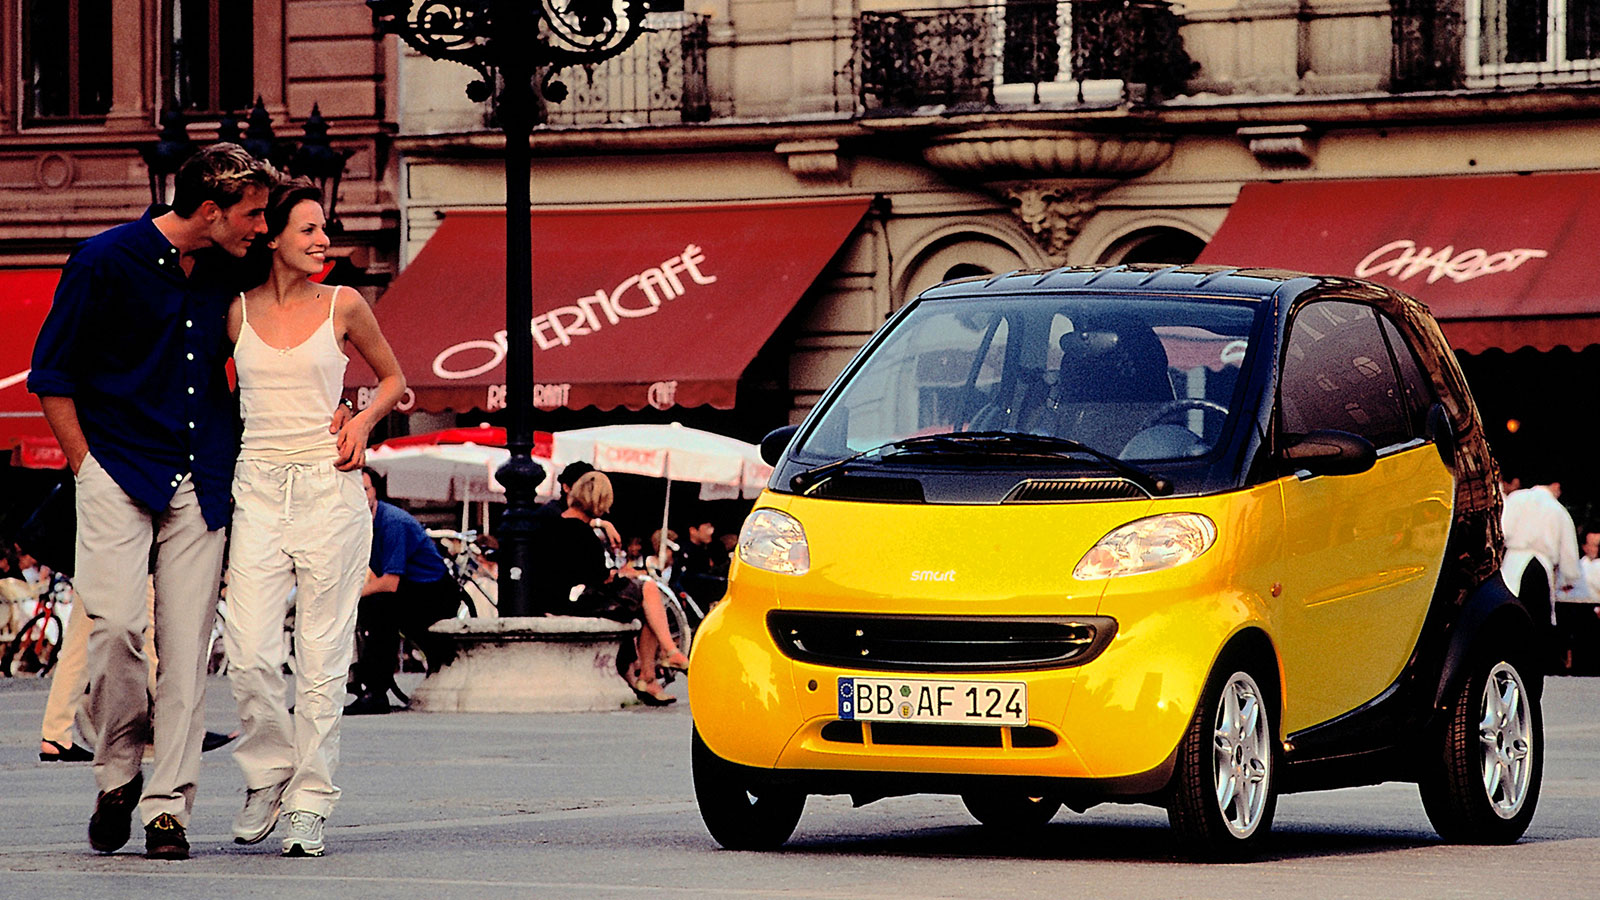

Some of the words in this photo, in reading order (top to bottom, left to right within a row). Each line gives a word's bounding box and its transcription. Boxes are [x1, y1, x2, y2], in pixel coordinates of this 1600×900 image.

[910, 569, 956, 582] smart
[857, 684, 894, 714] BB
[917, 686, 955, 716] AF
[965, 687, 1023, 718] 124
